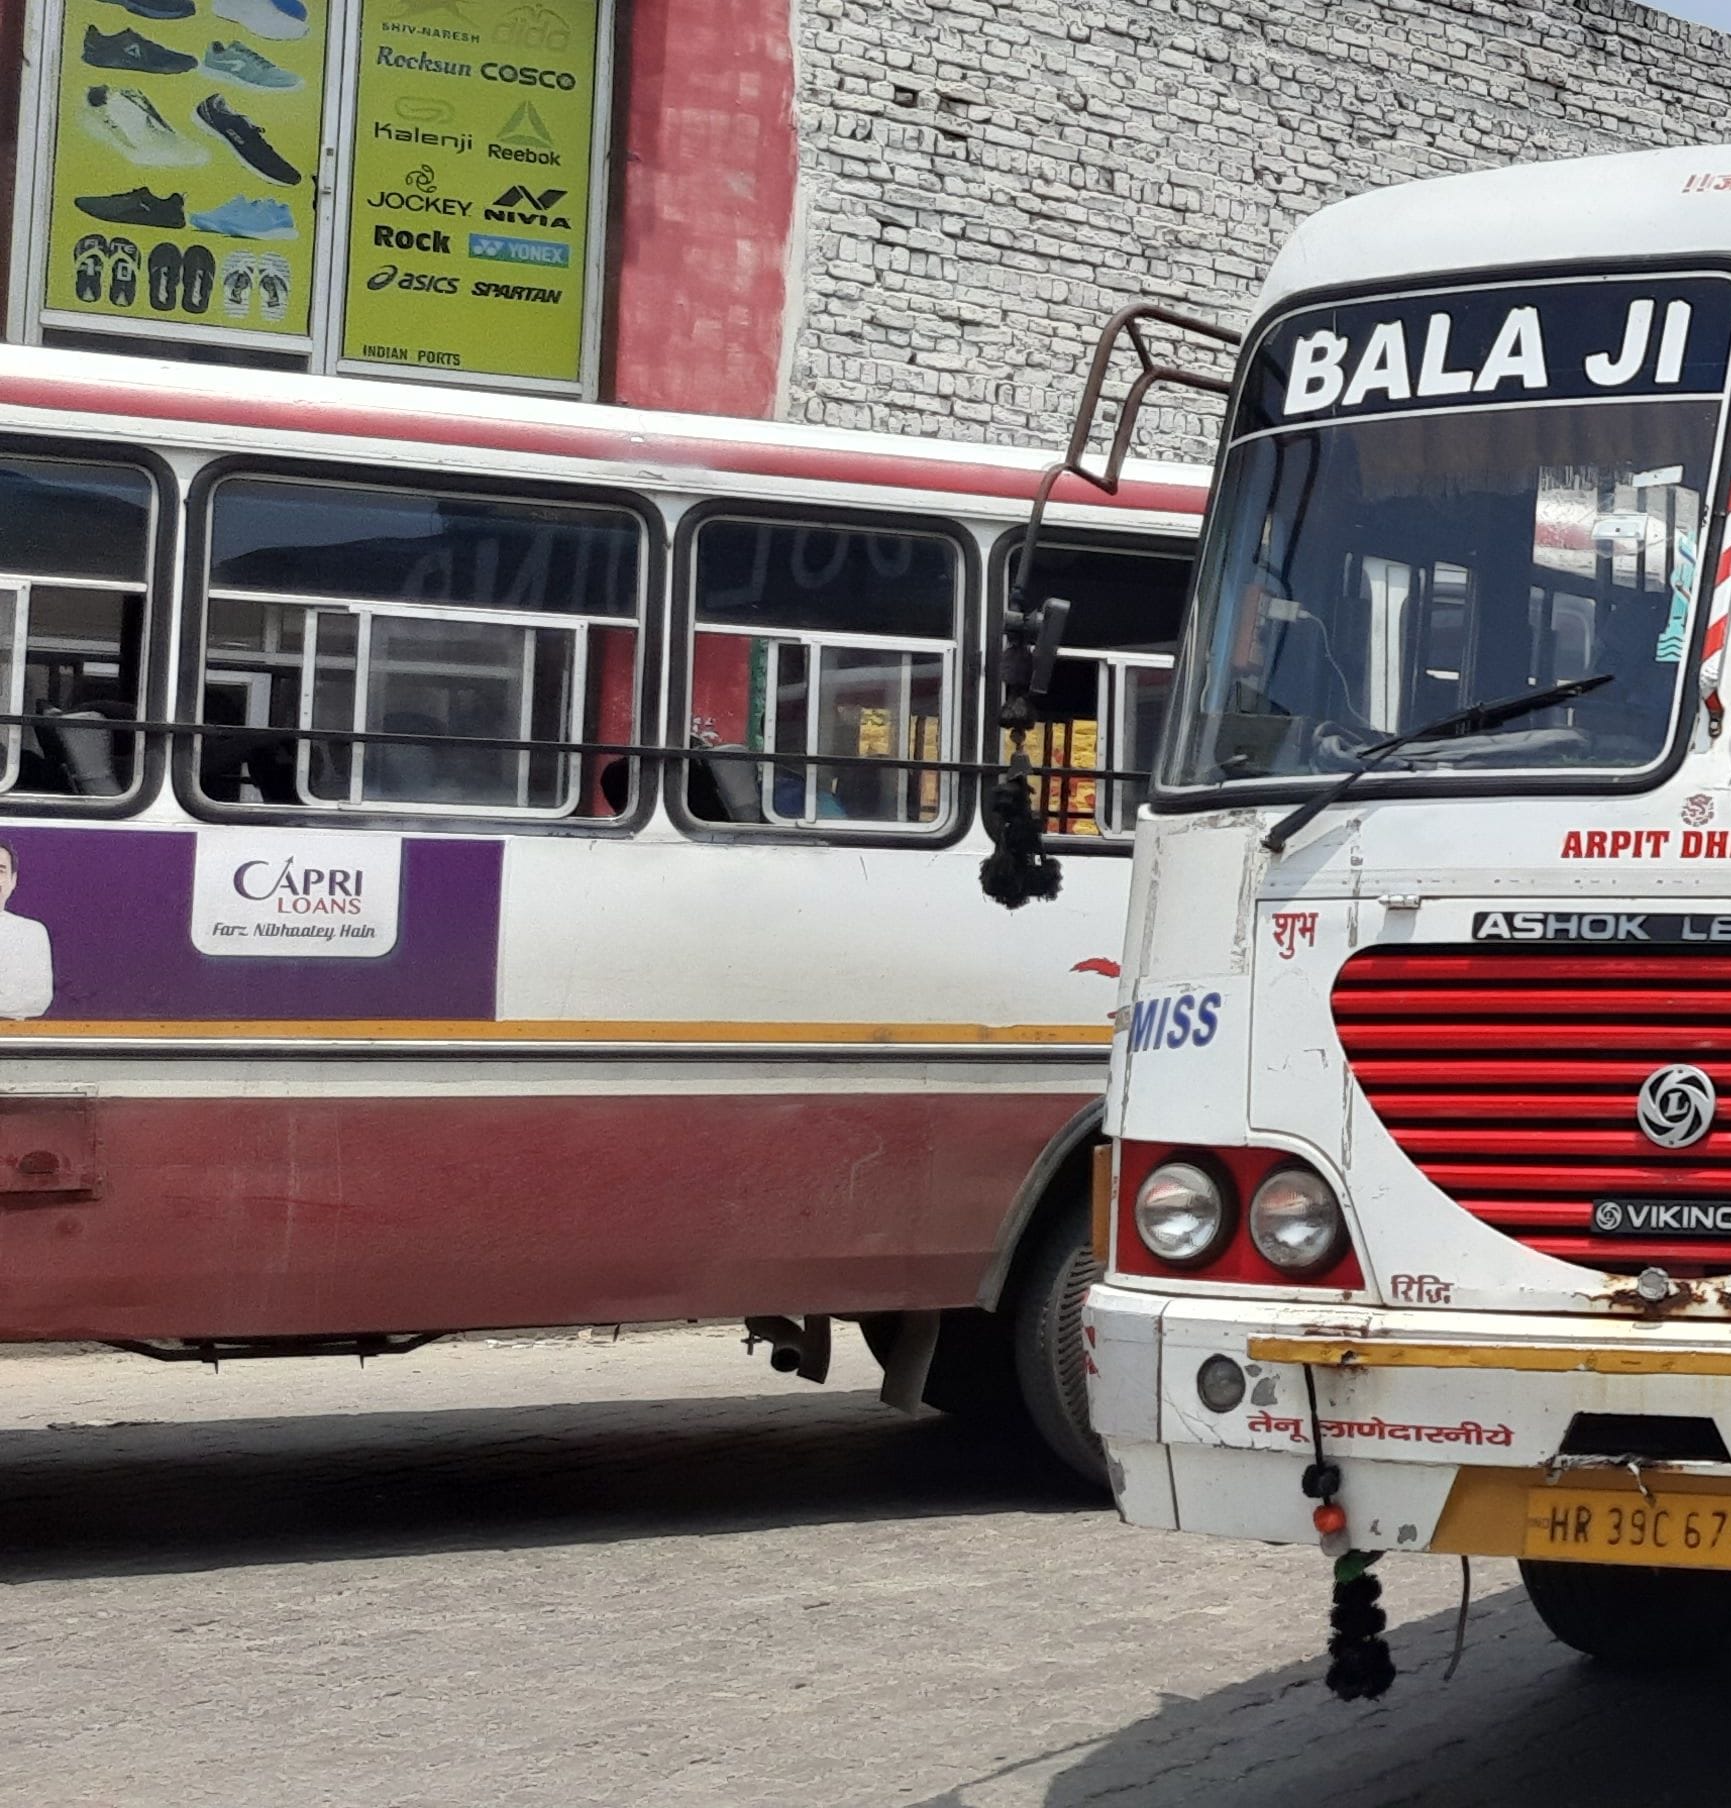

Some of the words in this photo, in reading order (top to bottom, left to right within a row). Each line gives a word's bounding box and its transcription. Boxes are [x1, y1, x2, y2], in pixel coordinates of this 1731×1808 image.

[381, 21, 481, 44] SHIV-NARESH
[376, 45, 472, 78] Rocksun
[480, 62, 577, 91] COSCO
[374, 121, 473, 154] Kalenji
[487, 143, 562, 167] Reebok
[366, 191, 474, 217] JOCKEY
[484, 208, 572, 230] NIVIA
[373, 224, 452, 254] Rock
[507, 246, 565, 265] YONEX
[471, 281, 563, 304] SPARTAN
[362, 344, 409, 361] INDIAN
[417, 349, 461, 366] PORTS
[1283, 304, 1549, 416] BALA
[1584, 298, 1692, 387] JI
[1561, 830, 1671, 859] ARPIT
[233, 855, 364, 901] CAPRI
[277, 897, 362, 915] LOANS
[212, 922, 249, 937] Farz
[339, 923, 376, 938] Hain
[1272, 911, 1319, 960] शुभ
[1476, 911, 1651, 940] ASHOK
[1131, 991, 1222, 1052] MISS
[1246, 1410, 1311, 1443] तेनू
[1549, 1505, 1593, 1544] HR
[1606, 1507, 1671, 1548] 39C
